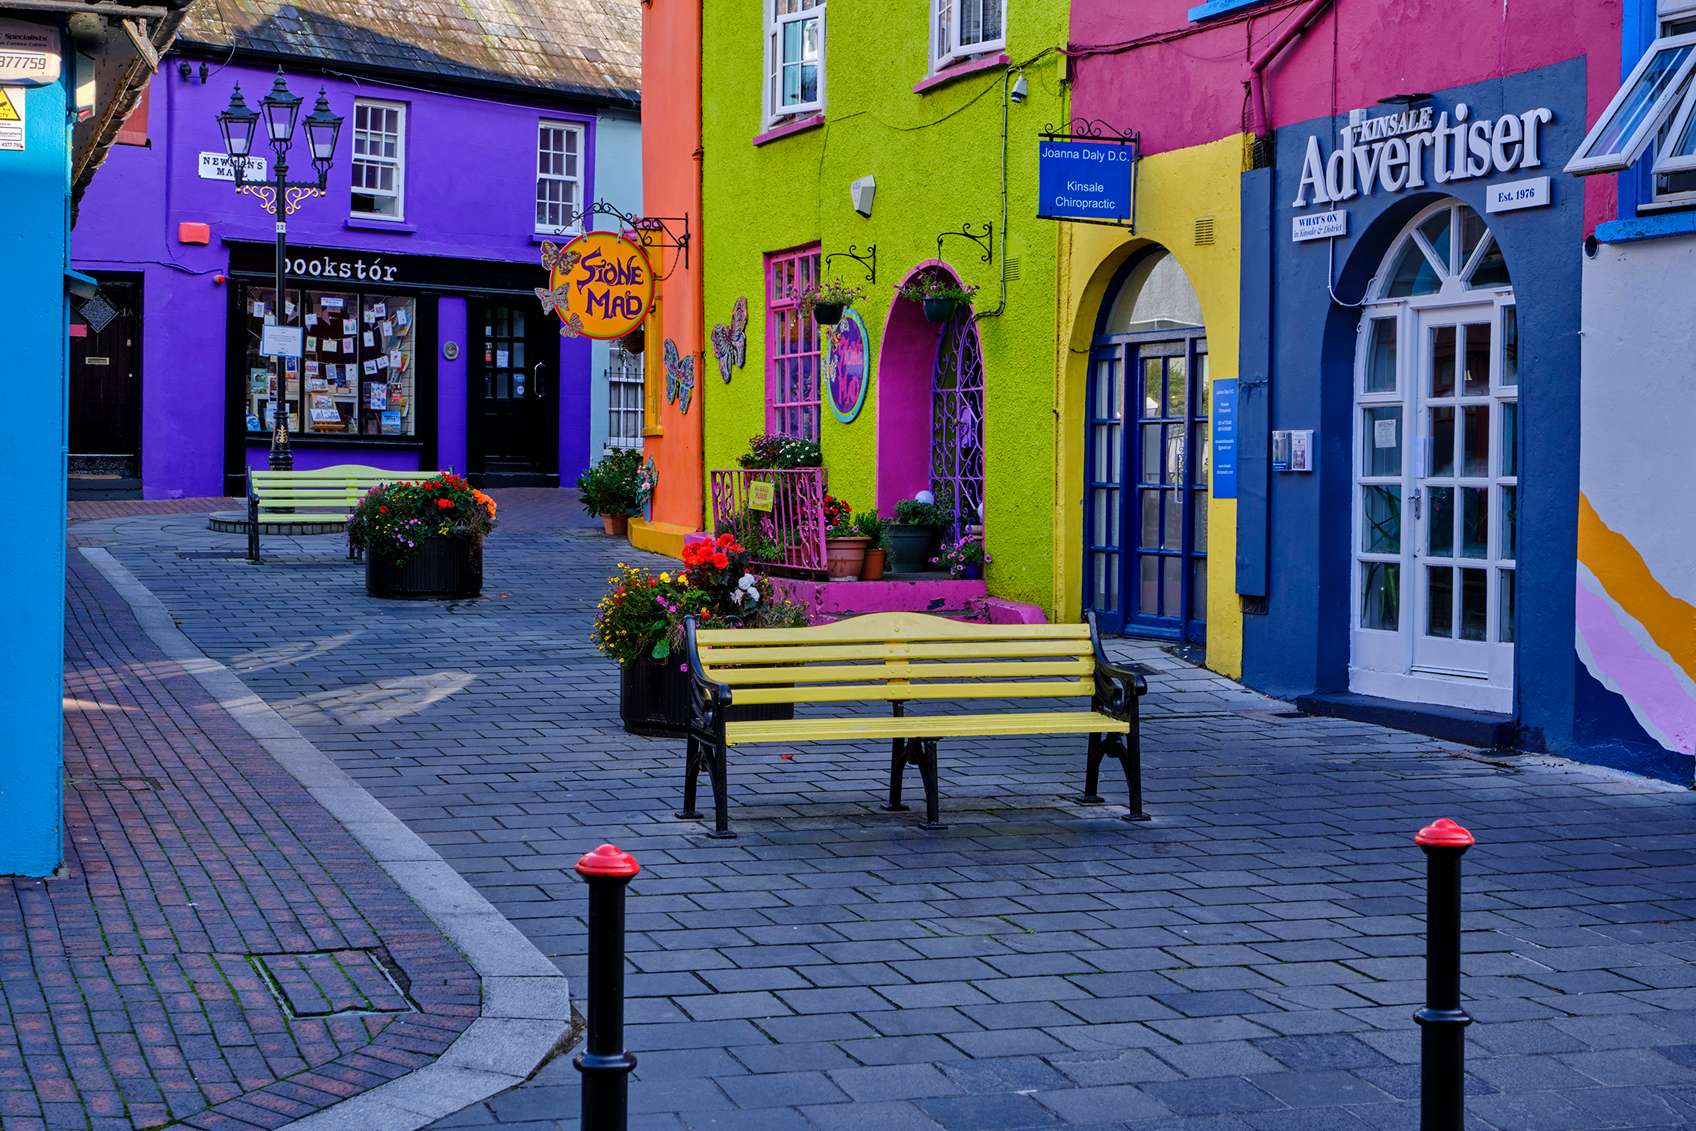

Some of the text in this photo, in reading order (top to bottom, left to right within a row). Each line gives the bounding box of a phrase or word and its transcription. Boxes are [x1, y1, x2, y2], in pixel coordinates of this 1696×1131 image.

[1359, 106, 1433, 143] KINSALE
[1042, 147, 1130, 163] Joanna Daly D.C.
[1292, 103, 1553, 208] Advertiser
[1067, 181, 1104, 193] Kinsale
[1498, 187, 1535, 202] Est. 1976
[1055, 196, 1116, 210] Chiropractic
[1299, 213, 1337, 226] WHAT'S ON
[585, 287, 643, 320] MAD
